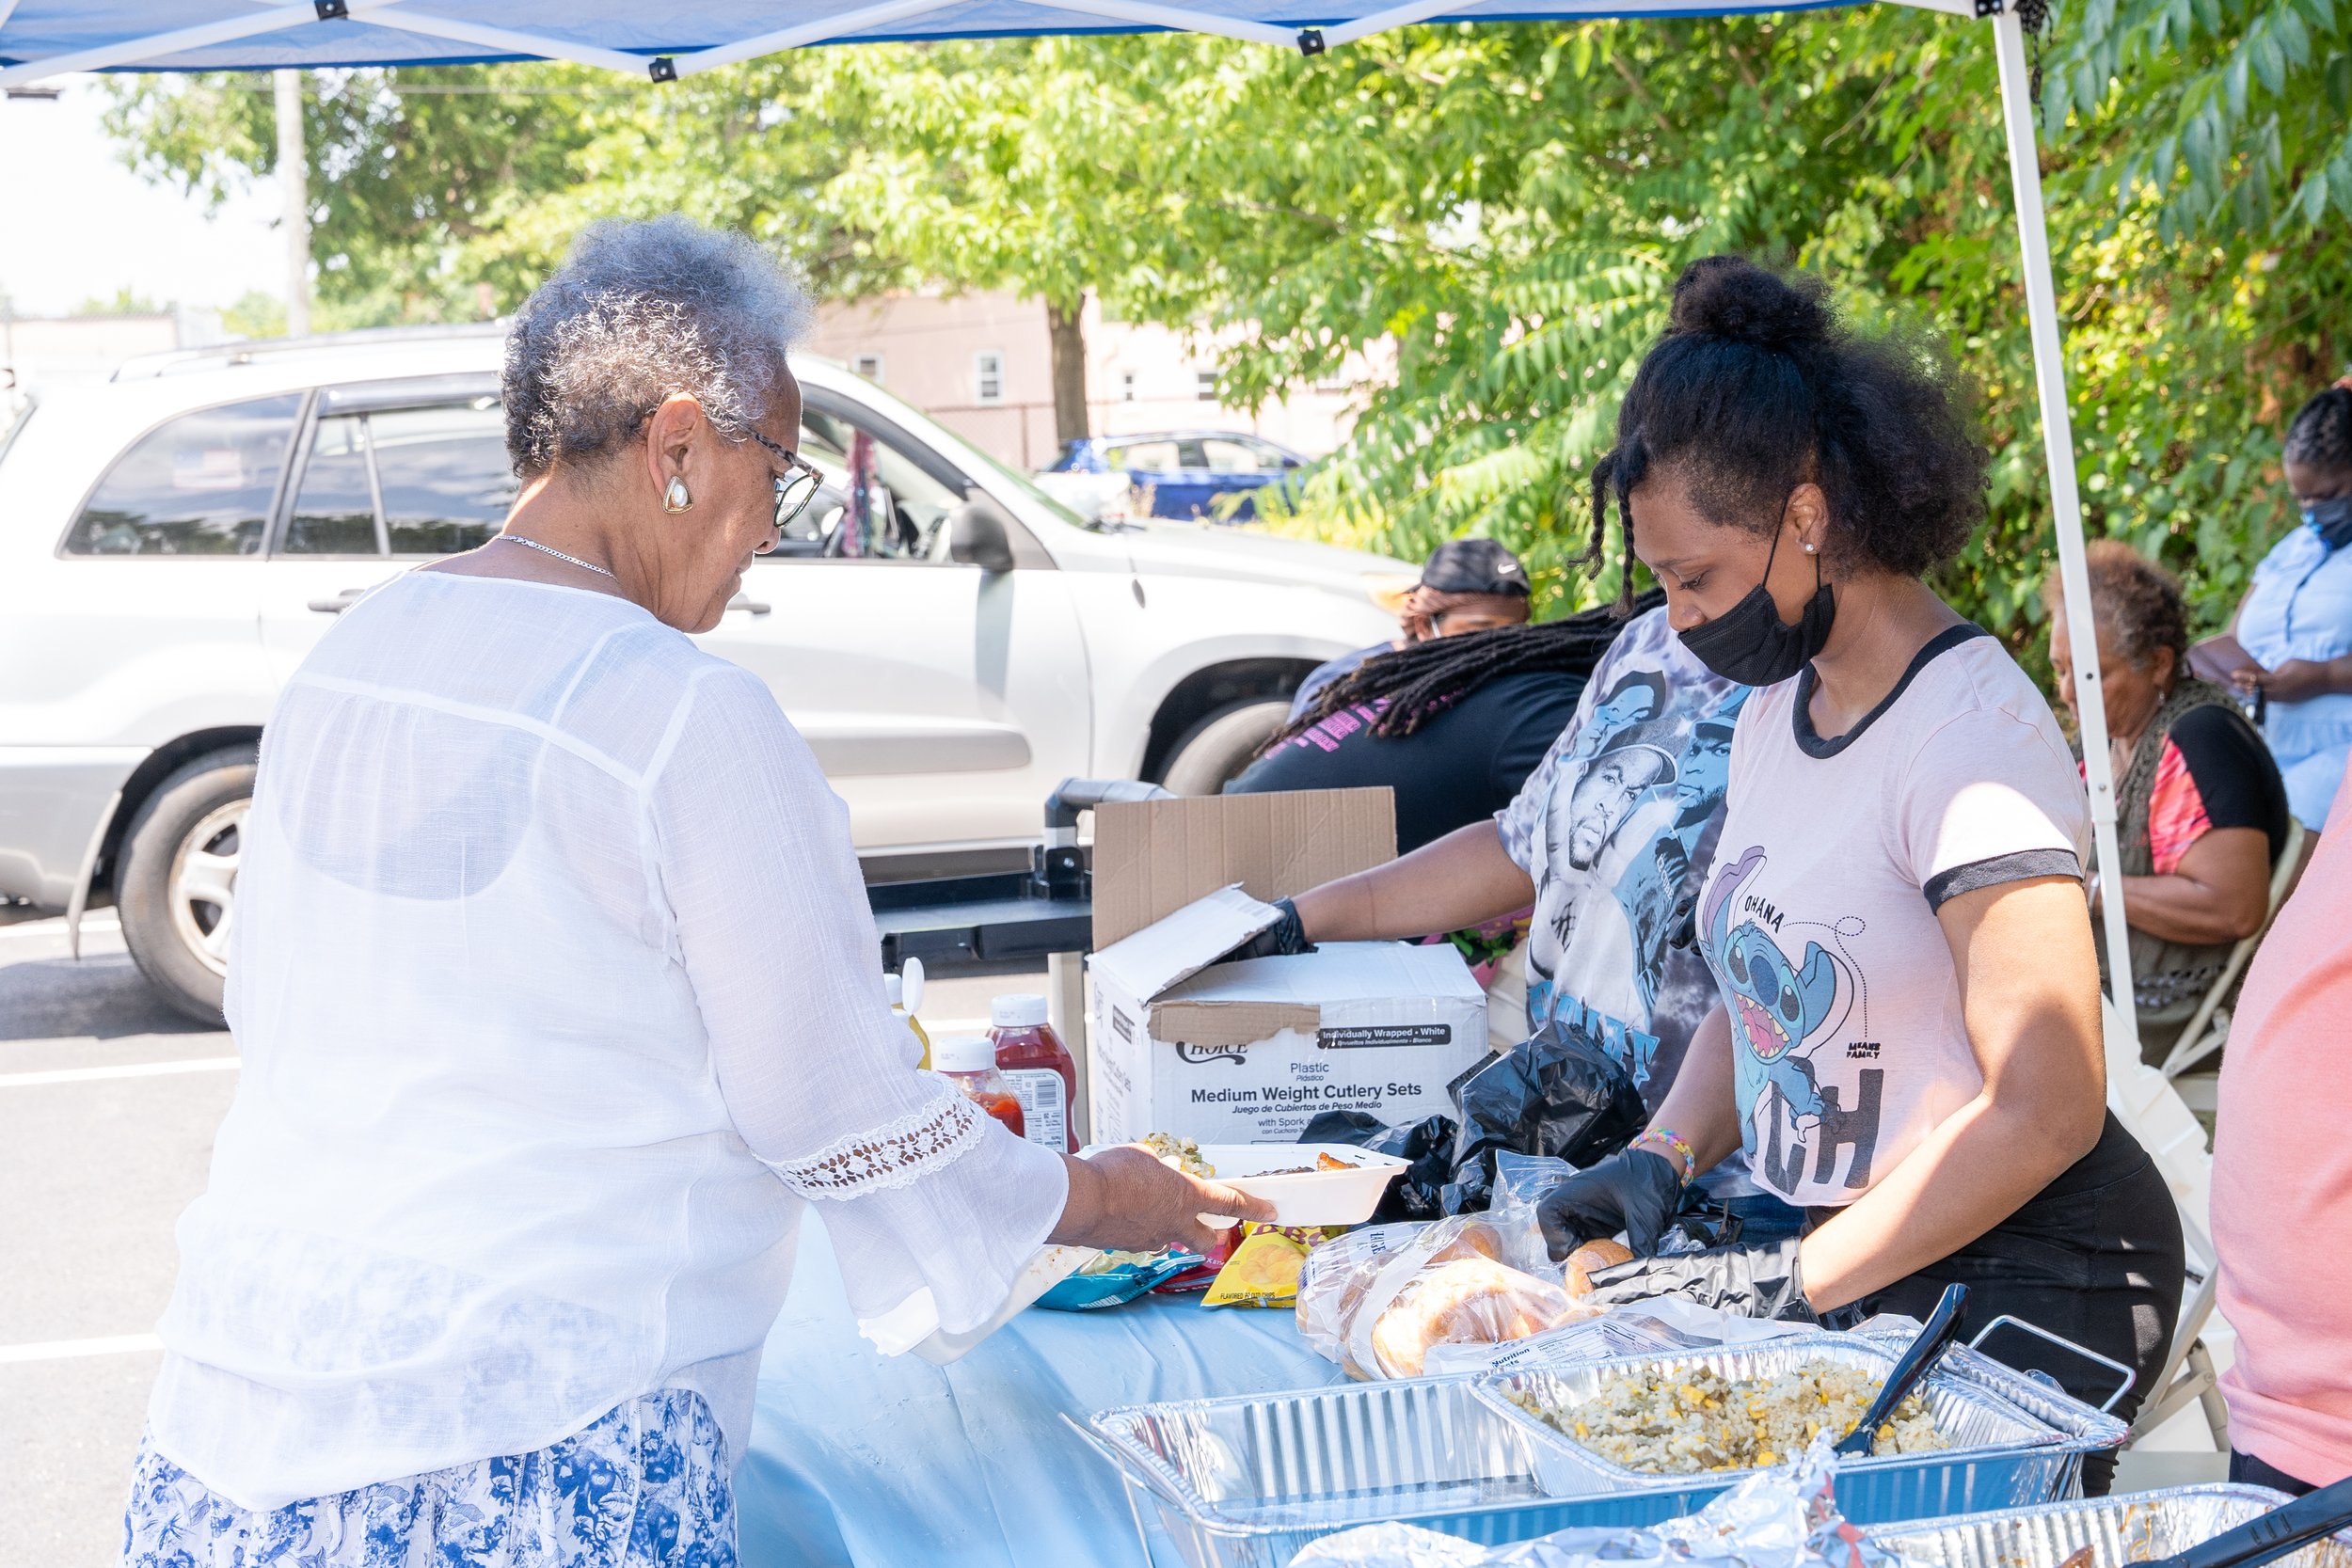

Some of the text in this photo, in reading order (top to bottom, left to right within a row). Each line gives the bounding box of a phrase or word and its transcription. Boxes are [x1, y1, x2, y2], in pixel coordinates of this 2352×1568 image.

[1745, 895, 1785, 934] OHANA
[1323, 1027, 1446, 1039] Individually Wrapped White
[1849, 1041, 1881, 1051] MEANS
[1846, 1051, 1880, 1059] FAMILY
[1291, 1062, 1329, 1073] Plastic
[1191, 1082, 1422, 1102] Medium Weight Cutlery Sets
[1232, 1101, 1382, 1115] Juego de Cubiertos de Peso Medio
[1258, 1118, 1277, 1127] with
[1279, 1117, 1305, 1127] Spork
[1491, 1348, 1530, 1368] Nutrition
